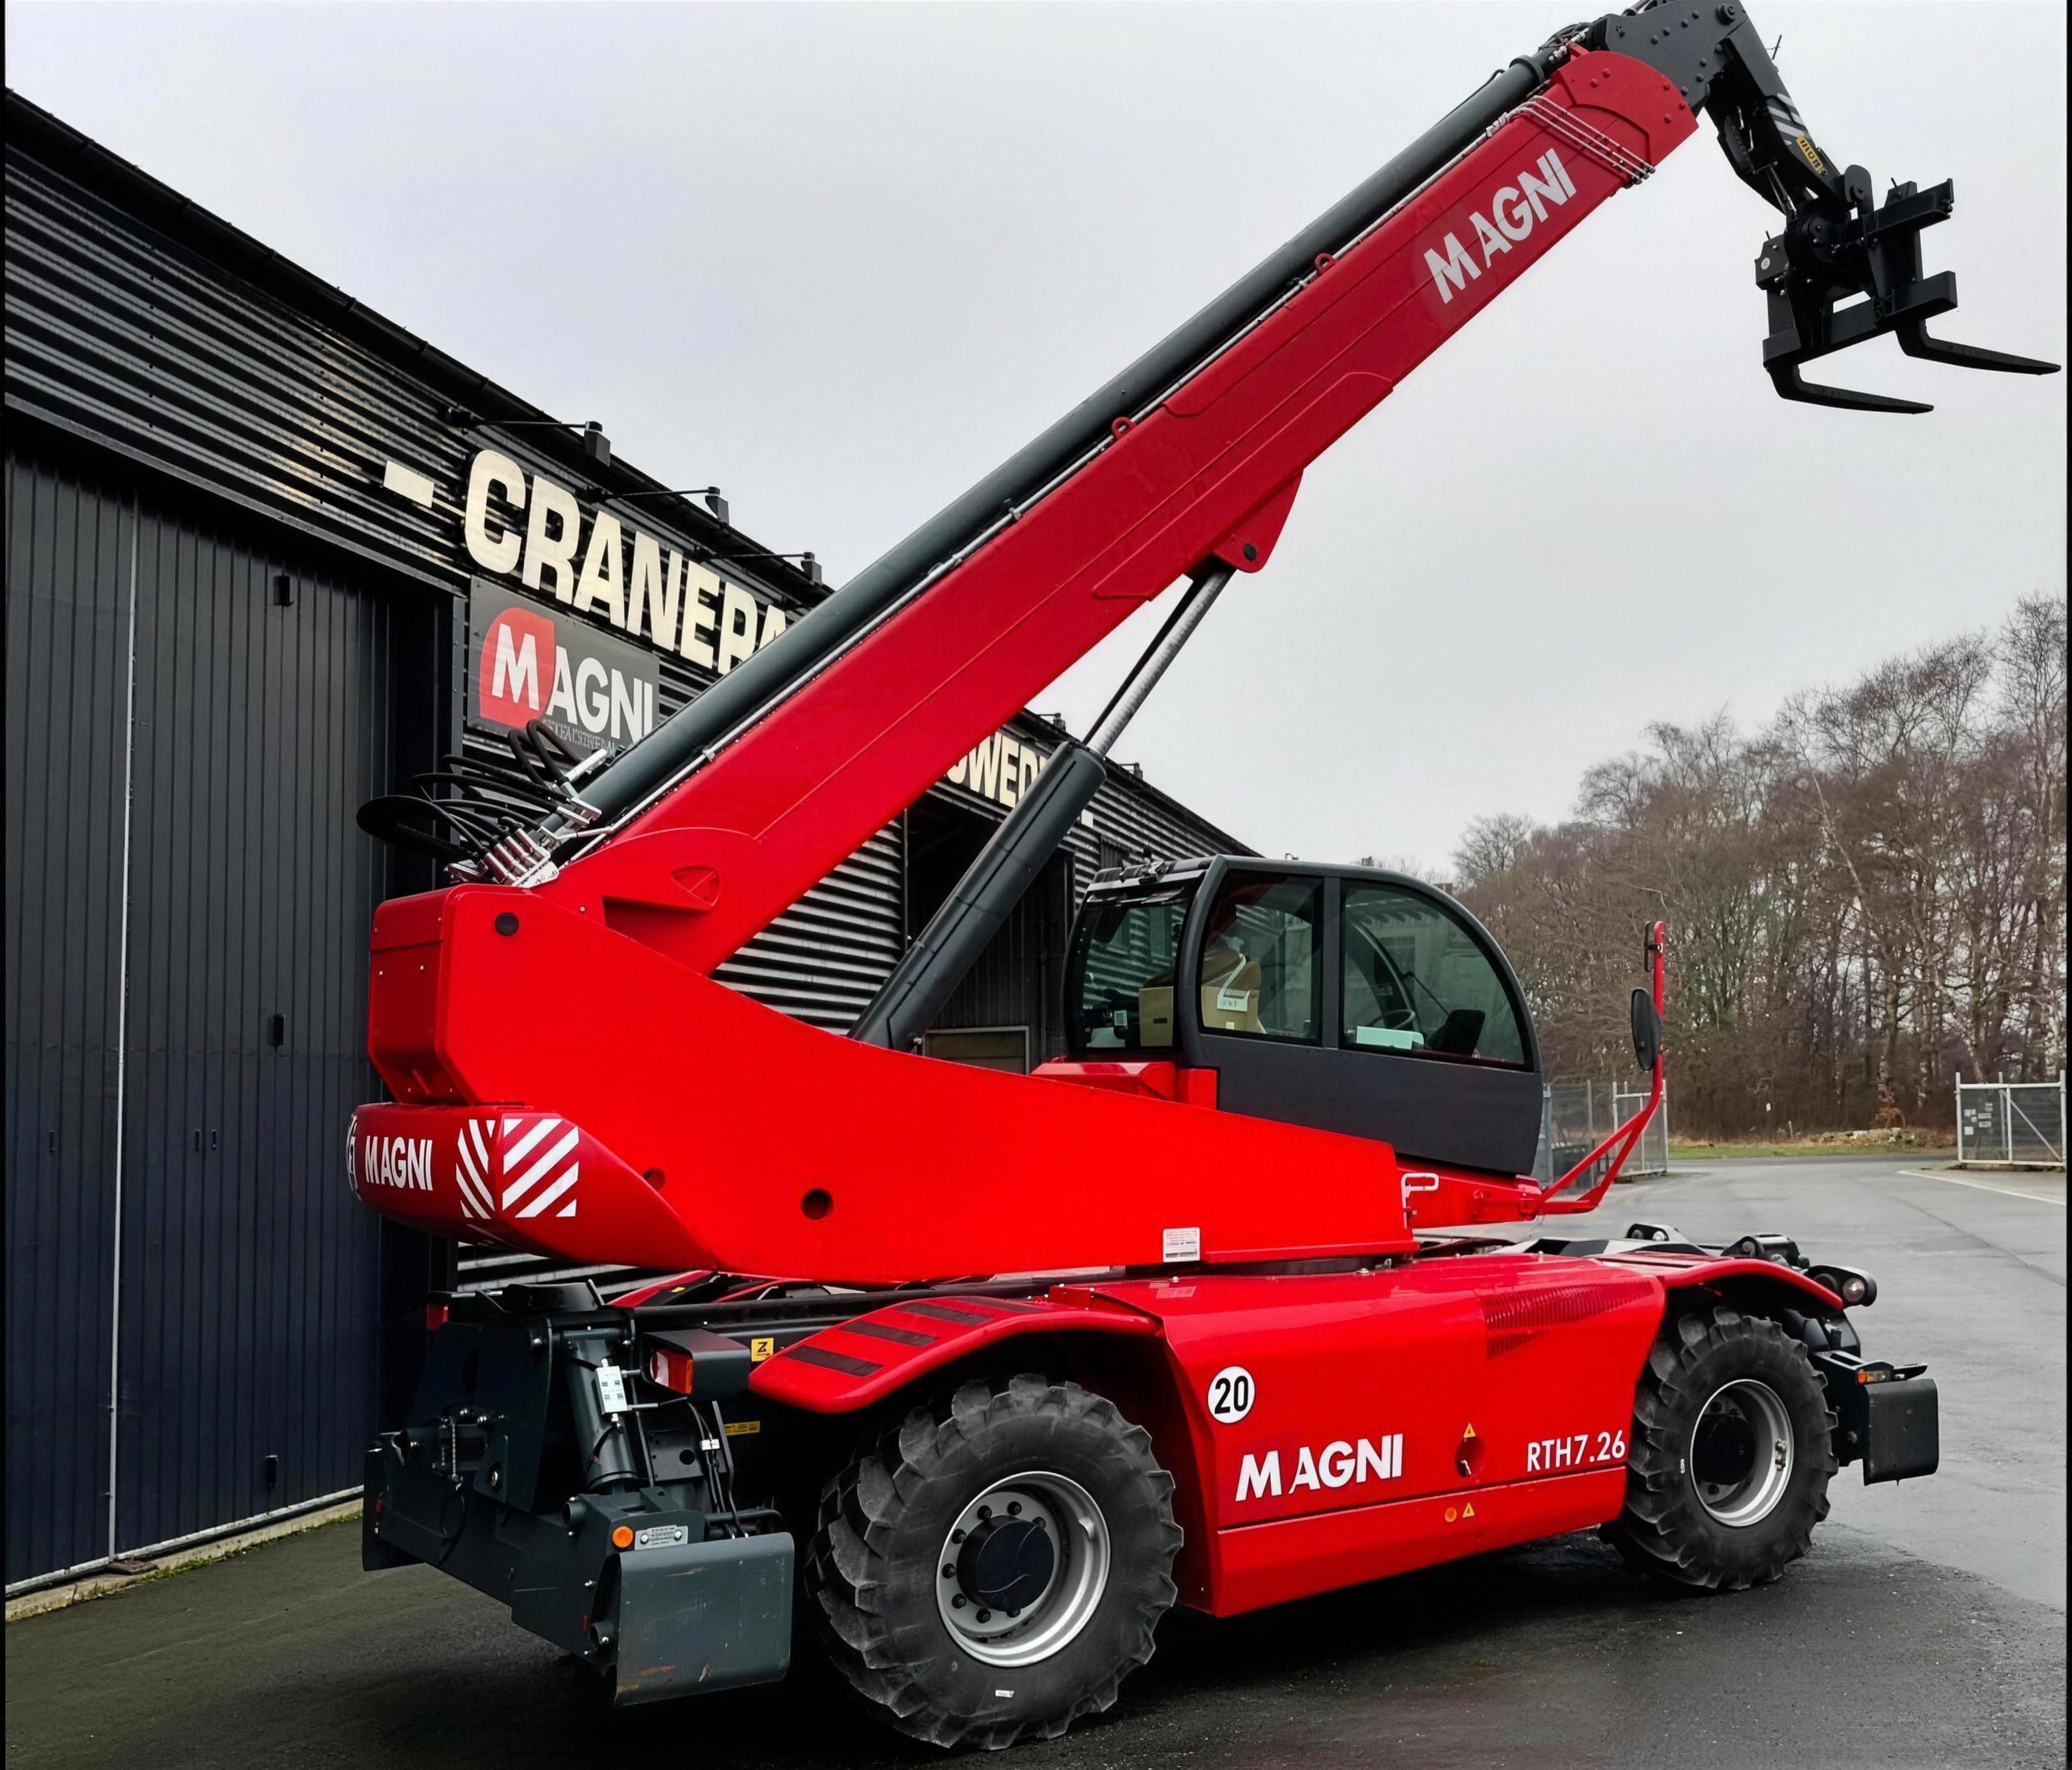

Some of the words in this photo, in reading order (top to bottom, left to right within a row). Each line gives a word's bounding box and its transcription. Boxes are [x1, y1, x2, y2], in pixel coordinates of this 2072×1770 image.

[1423, 147, 1577, 304] MAGNI
[491, 623, 653, 744] MAGNI
[945, 731, 1049, 808] WED
[364, 1135, 433, 1191] MAGNI
[1215, 1375, 1249, 1414] 20
[1235, 1433, 1404, 1502] MAGNI
